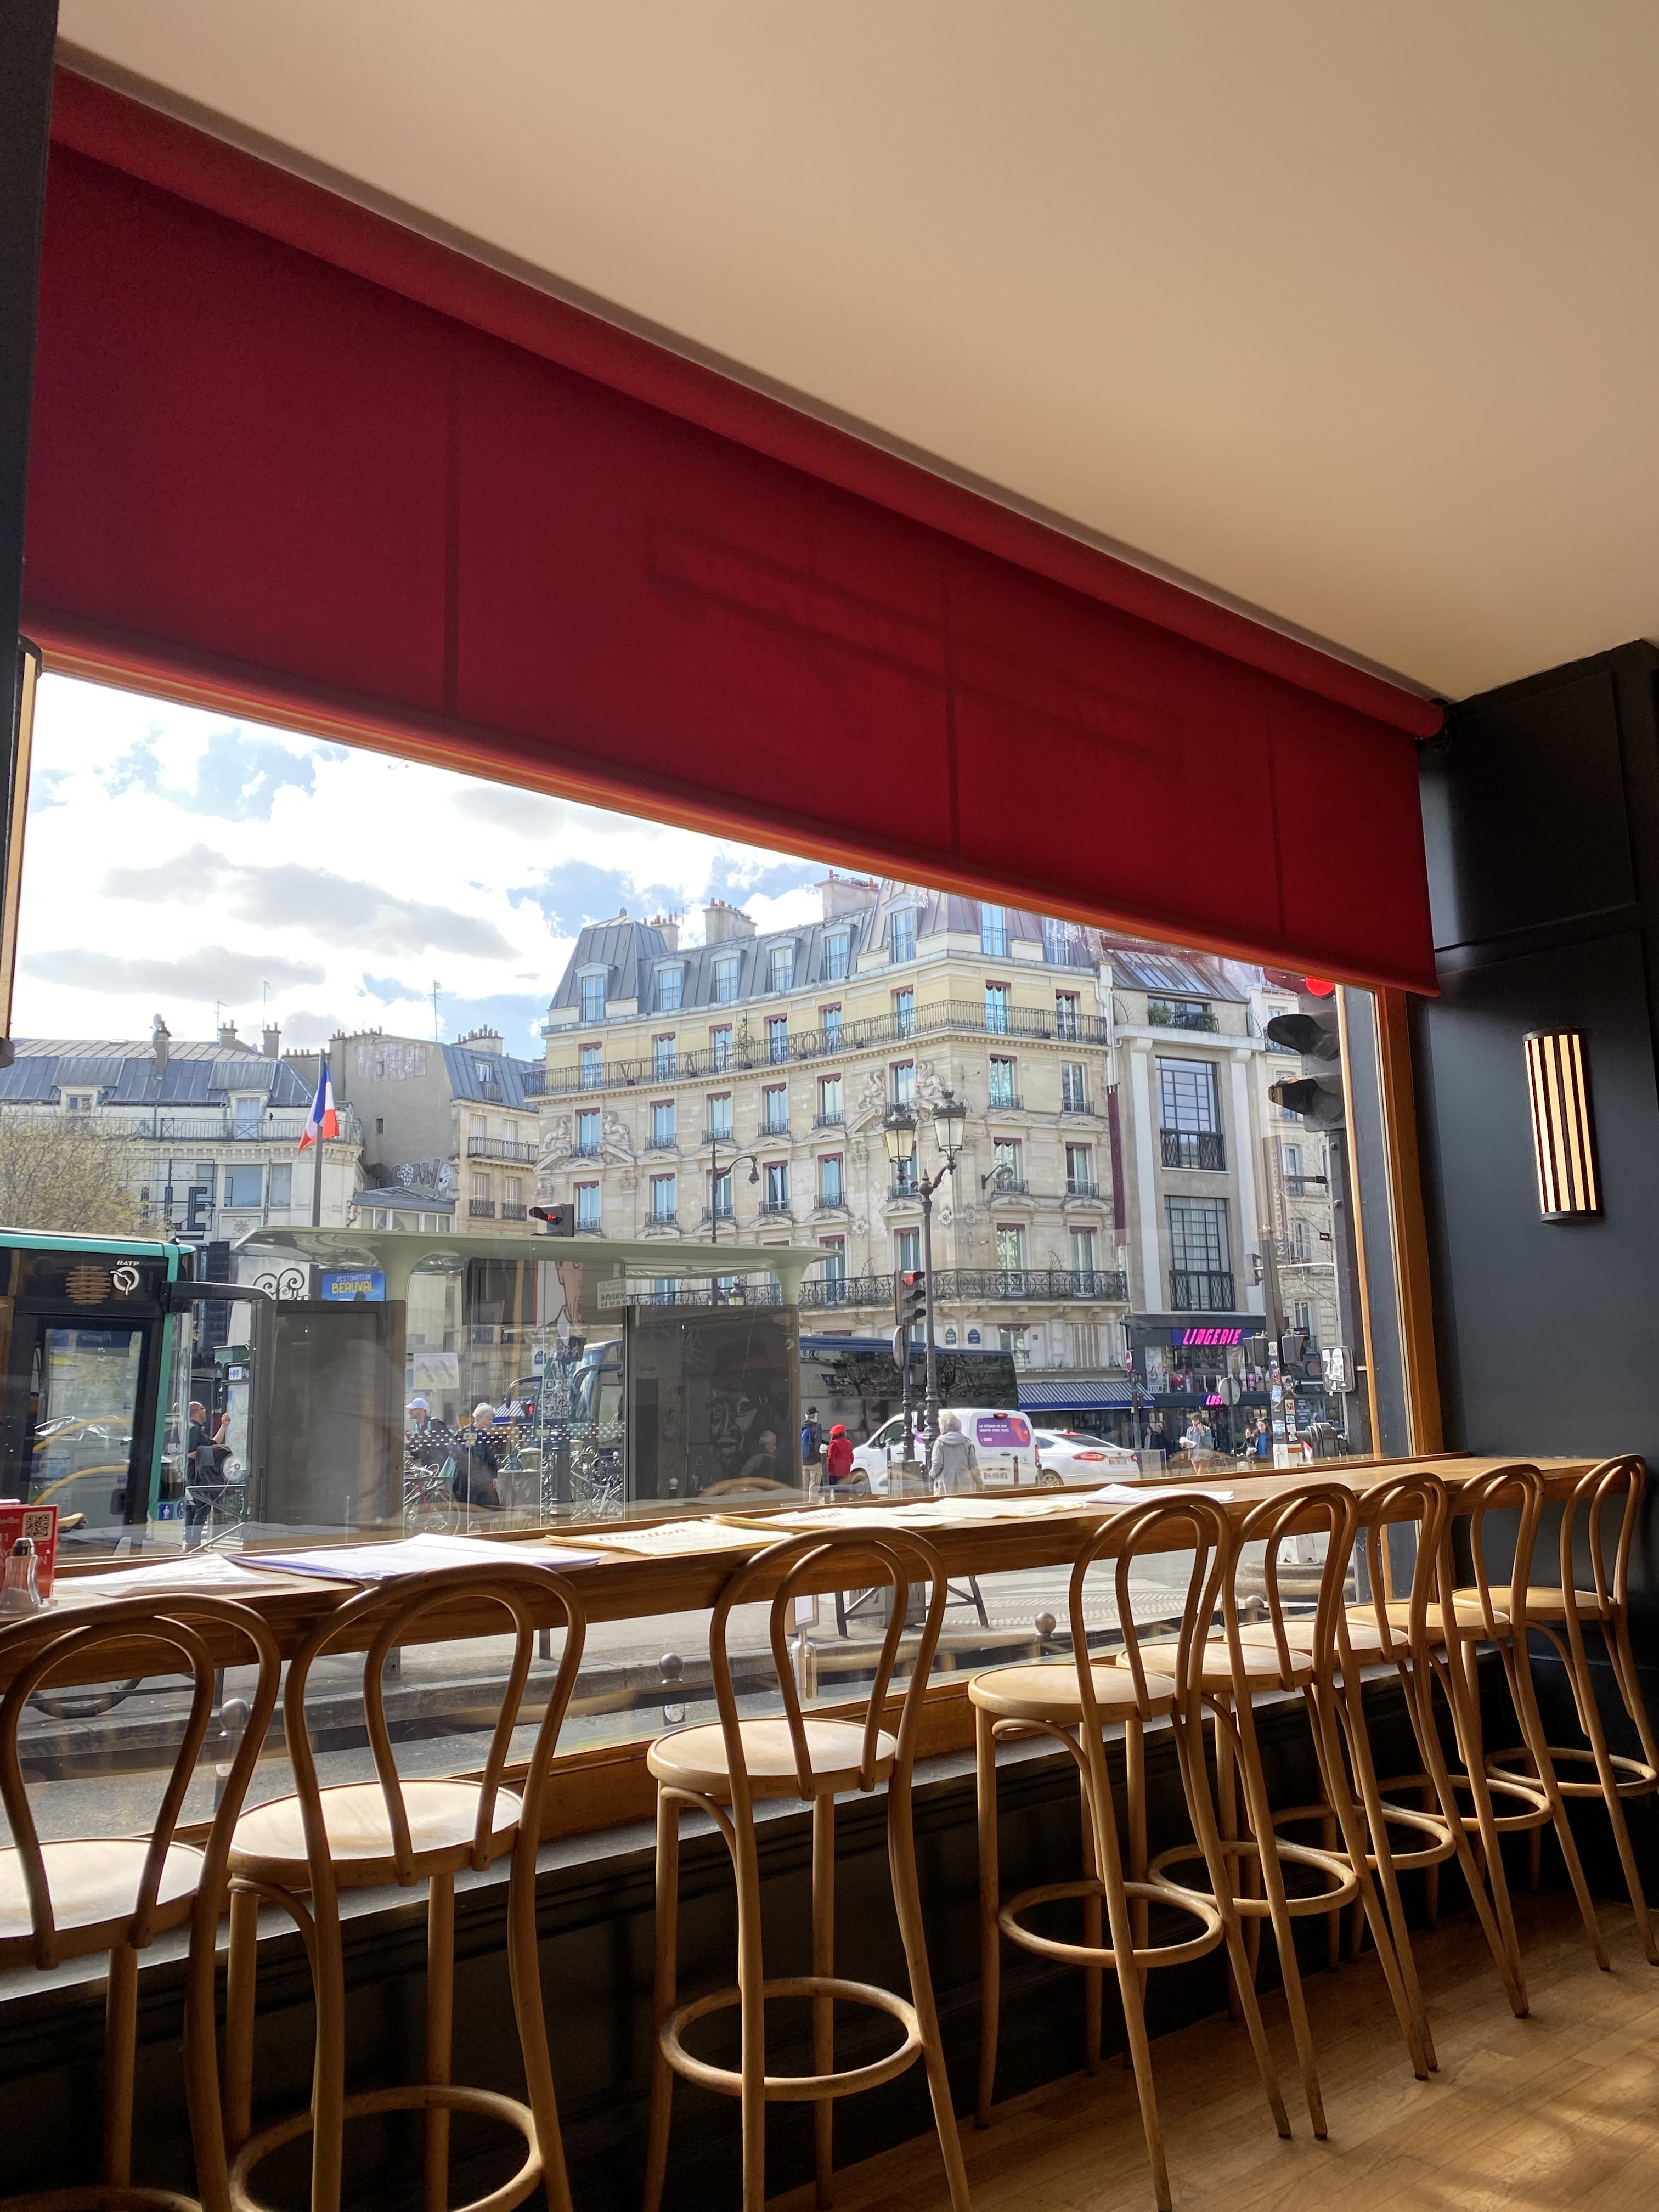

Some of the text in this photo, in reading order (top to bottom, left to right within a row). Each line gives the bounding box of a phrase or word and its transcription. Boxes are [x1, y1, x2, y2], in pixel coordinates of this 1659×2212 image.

[1273, 1189, 1284, 1256] Mercure
[336, 1274, 371, 1282] DESTINATION
[331, 1280, 375, 1294] BEAUVAL
[1183, 1328, 1242, 1345] LINGERIE
